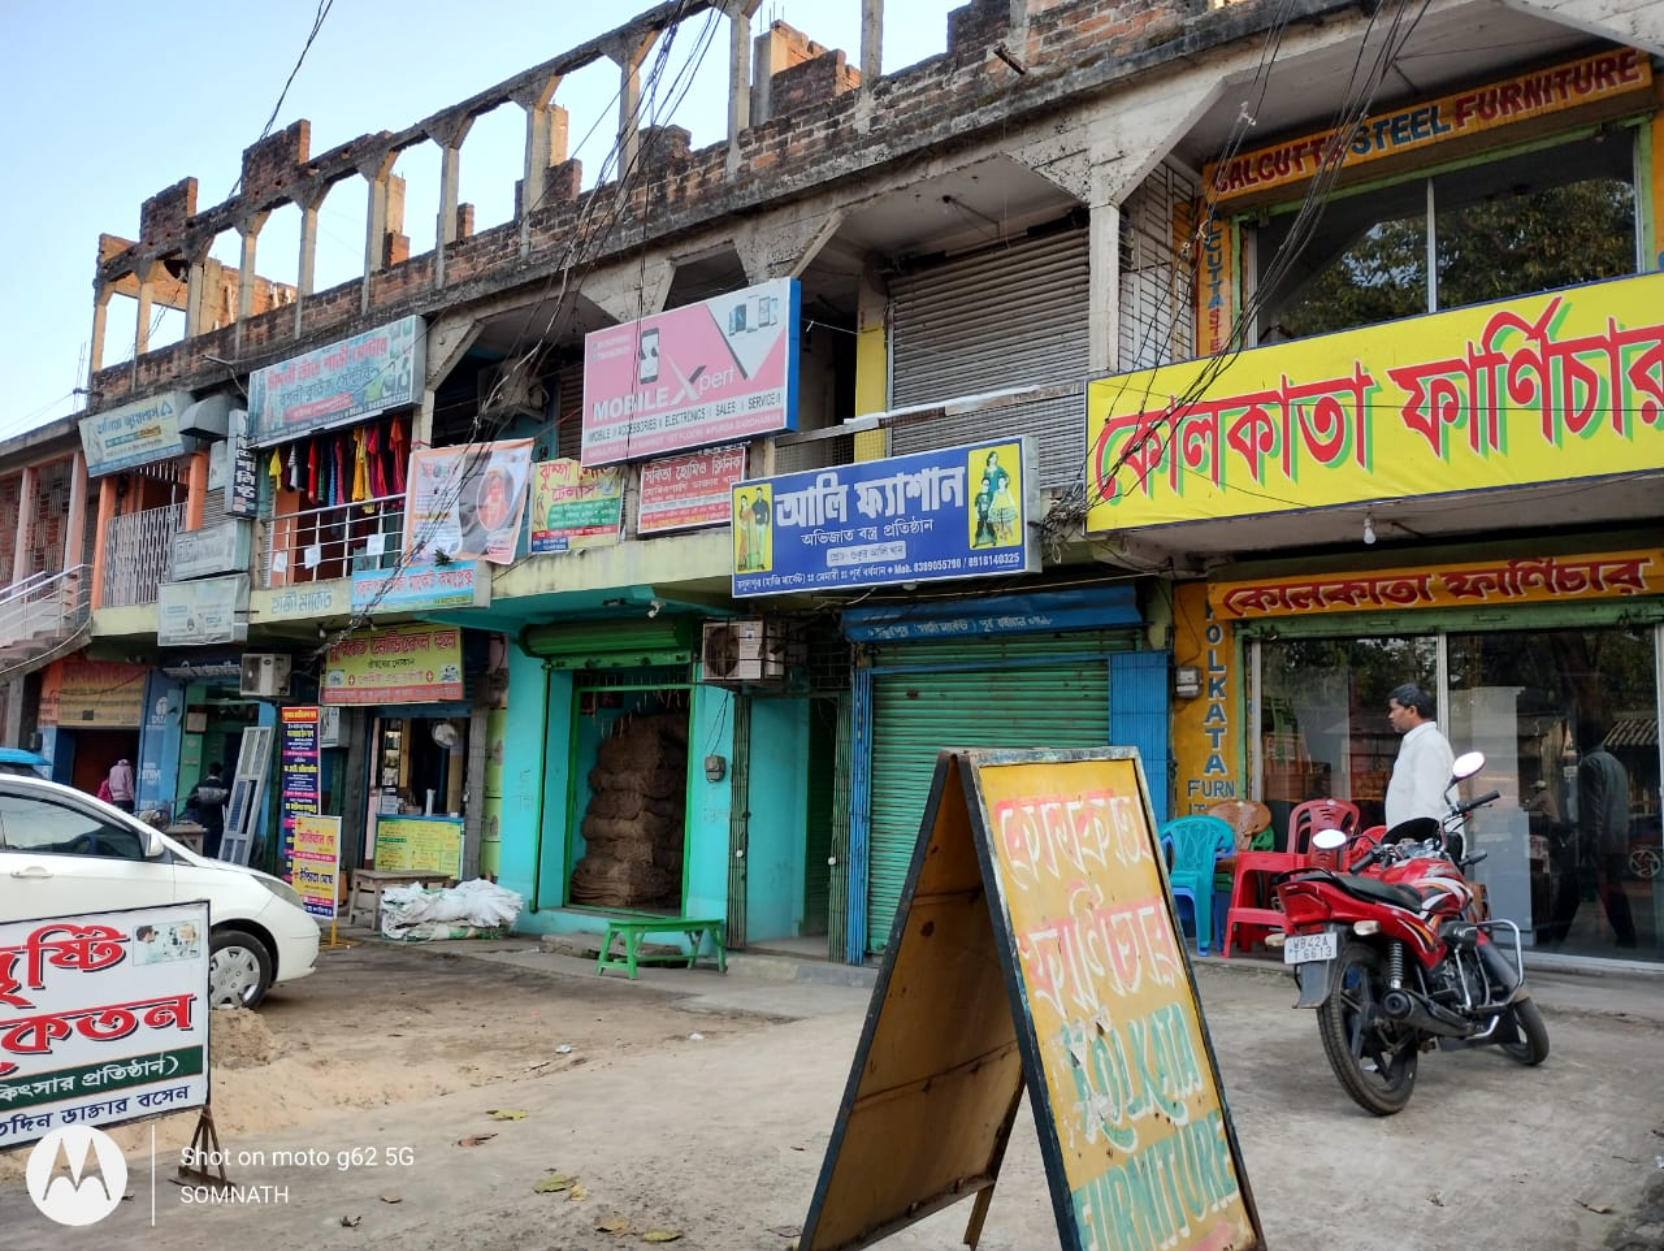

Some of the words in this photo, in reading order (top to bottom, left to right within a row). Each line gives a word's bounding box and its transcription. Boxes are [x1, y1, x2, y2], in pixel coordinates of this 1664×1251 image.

[1211, 131, 1345, 194] CALCUTTA
[1350, 104, 1452, 156] STEEL
[1455, 49, 1644, 128] FURNITURE
[592, 386, 669, 423] MOBILE
[665, 408, 706, 428] ELECTRONICS
[716, 401, 736, 417] SALES
[1095, 360, 1377, 504] কোলকাতা
[773, 471, 848, 528] আলি
[801, 526, 854, 547] অভিজাত
[883, 516, 934, 539] প্রতিষ্ঠান
[1222, 573, 1432, 617] কোলকাতা
[1204, 600, 1227, 777] OLKATA
[81, 1053, 180, 1087] প্রতিষ্ঠান)
[60, 1096, 130, 1124] ডাক্তার
[136, 1085, 191, 1108] বসেন
